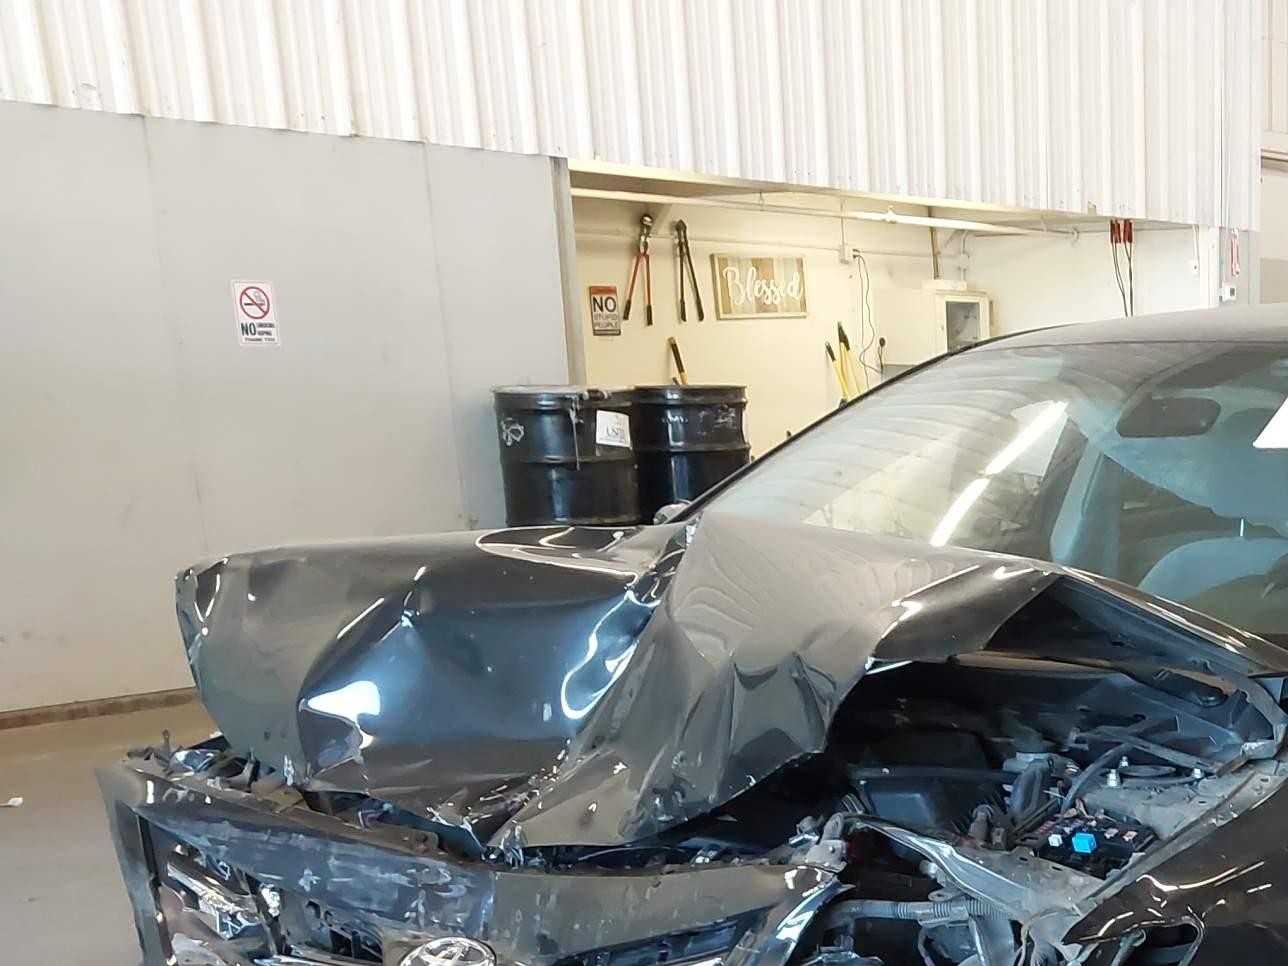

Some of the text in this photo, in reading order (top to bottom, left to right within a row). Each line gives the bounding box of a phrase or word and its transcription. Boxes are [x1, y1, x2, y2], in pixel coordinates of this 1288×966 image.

[723, 266, 803, 305] Blessed
[593, 296, 616, 312] NO
[241, 322, 256, 336] NO
